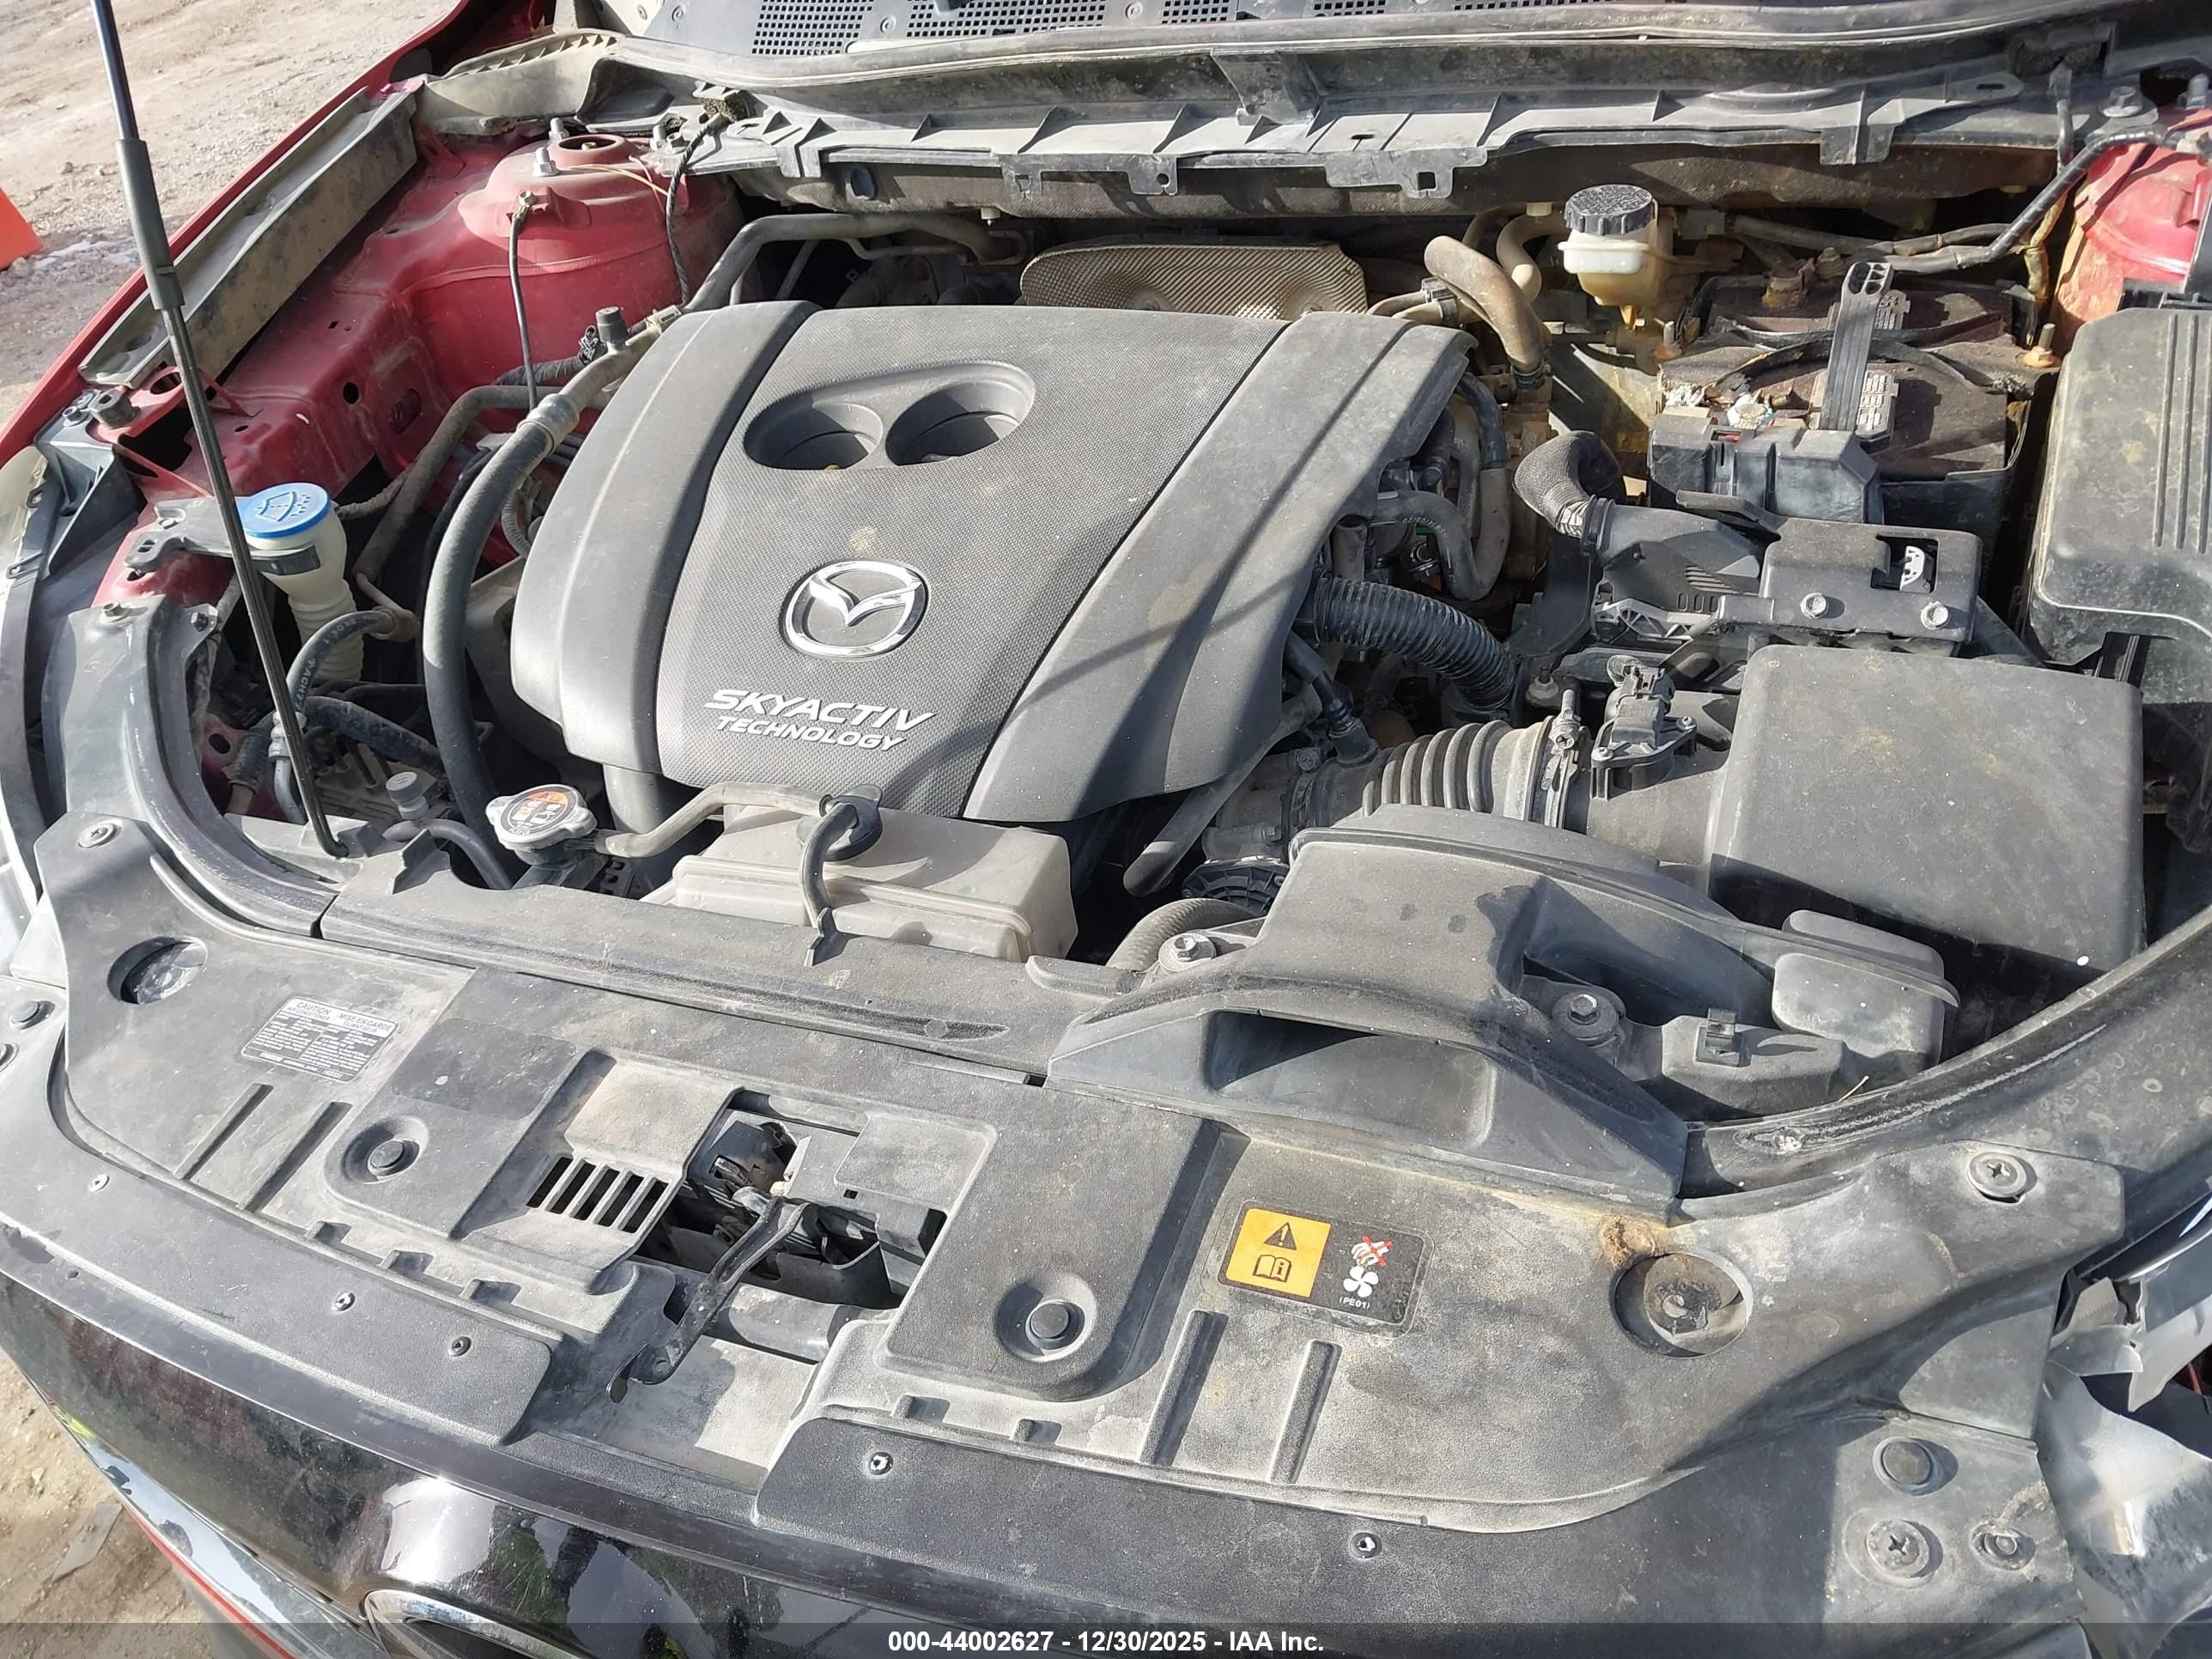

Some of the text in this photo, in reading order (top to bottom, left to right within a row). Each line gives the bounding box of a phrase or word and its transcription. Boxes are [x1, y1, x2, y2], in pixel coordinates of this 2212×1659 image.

[703, 688, 936, 732] SKYACTIV
[716, 714, 907, 751] TECHNOLOGY
[296, 1001, 331, 1015] CAUTION
[338, 1012, 358, 1022] MISE
[367, 1019, 392, 1031] GARDE
[1339, 1296, 1370, 1310] (PE01)
